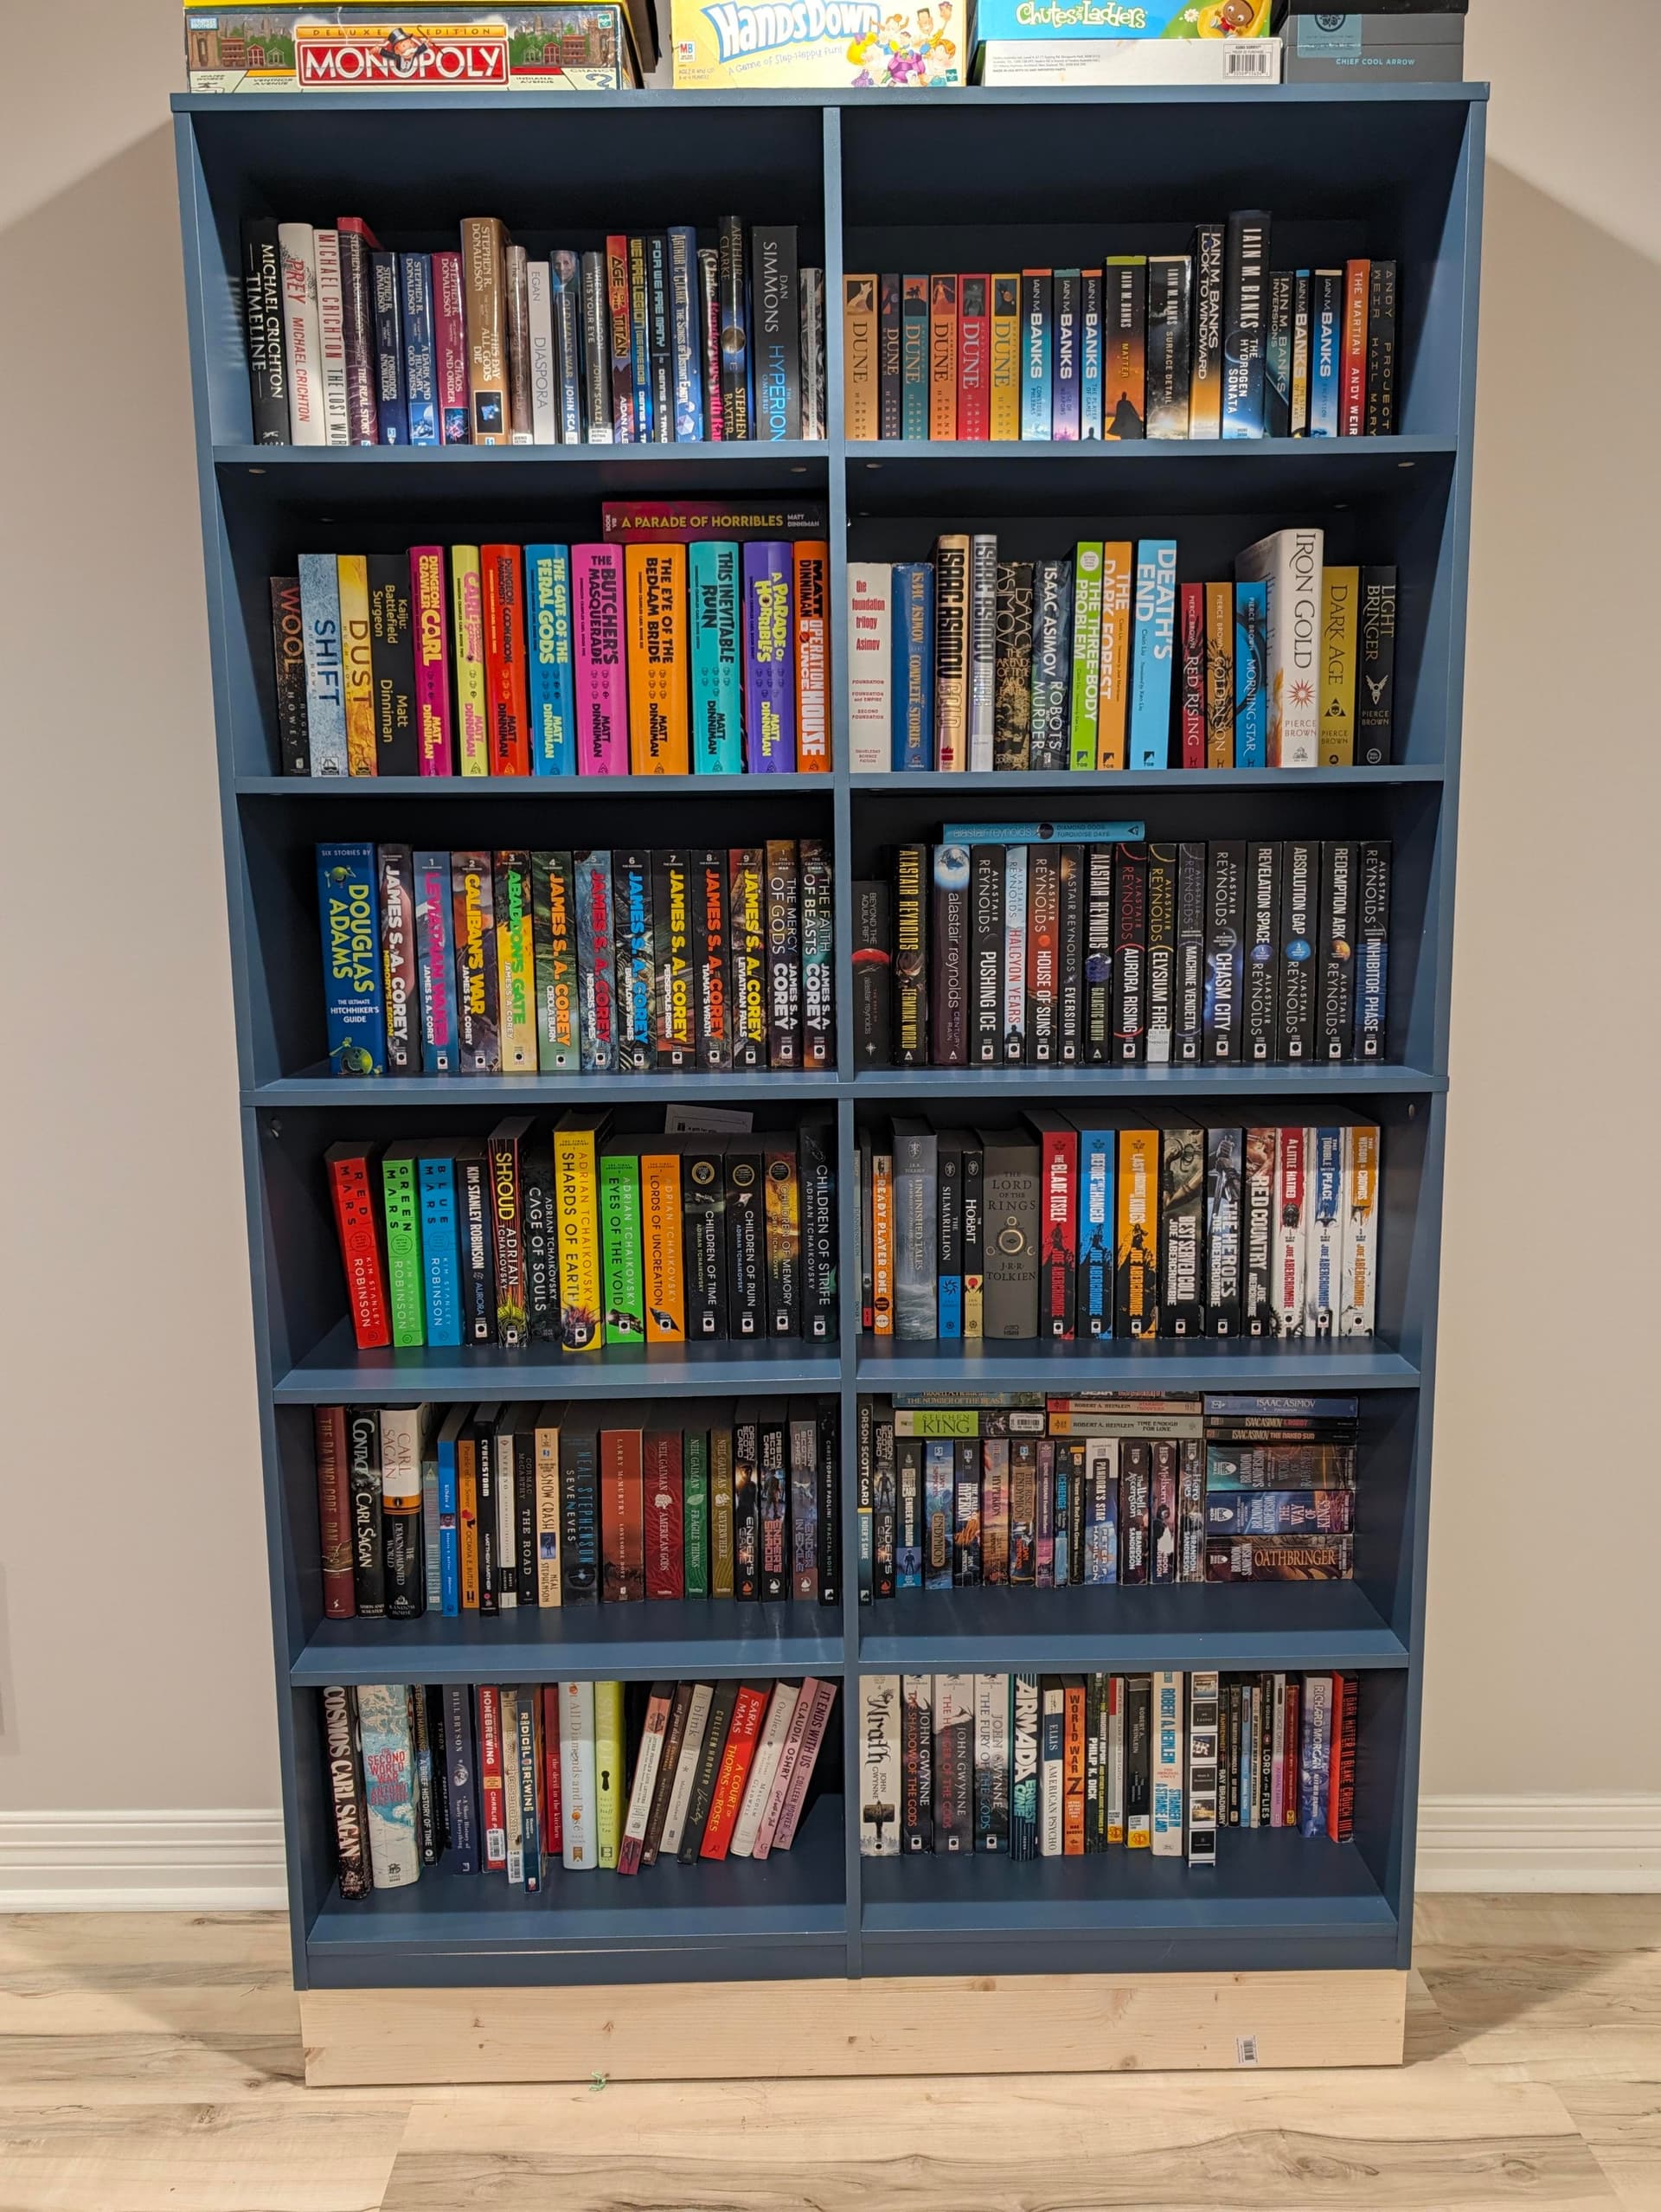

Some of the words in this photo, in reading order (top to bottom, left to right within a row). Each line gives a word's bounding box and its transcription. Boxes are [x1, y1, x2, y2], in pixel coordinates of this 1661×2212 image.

[1016, 2, 1076, 28] Chutes
[1082, 0, 1145, 28] Ladders
[680, 44, 693, 54] MB
[736, 61, 761, 73] Game
[764, 56, 773, 66] of
[318, 234, 338, 290] MICHAEL
[1242, 228, 1261, 258] IAIN
[260, 244, 273, 313] MICHAEL
[285, 257, 306, 304] PREY
[531, 272, 541, 301] EGAN
[763, 242, 779, 332] SIMMONS
[779, 276, 788, 299] DAN
[1241, 266, 1260, 282] M.
[247, 274, 266, 371] TIMELINE
[322, 297, 343, 358] CRICHTON
[1241, 285, 1260, 328] BANKS
[1352, 300, 1362, 355] MARTIAN
[266, 317, 284, 399] CRICHTON
[853, 323, 867, 383] DUNE
[963, 323, 978, 388] DUNE
[1030, 313, 1042, 378] BANKS
[327, 369, 343, 388] THE
[535, 337, 548, 408] DIASPORA
[768, 346, 786, 441] HYPERION
[1350, 368, 1359, 399] ANDY
[328, 393, 346, 417] LOST
[1349, 402, 1358, 435] WEIR
[621, 517, 631, 528] A
[635, 516, 687, 528] PARADE
[690, 516, 708, 526] OF
[712, 516, 783, 527] HORRIBLES
[1289, 533, 1316, 593] IRON
[646, 557, 659, 616] BEDLAM
[700, 585, 717, 628] RUN
[852, 599, 885, 611] foundation
[856, 580, 866, 593] the
[1044, 567, 1057, 612] ISAAC
[1102, 561, 1116, 617] DARK
[1135, 564, 1156, 622] END
[1154, 549, 1176, 659] DEATH'S
[373, 591, 383, 637] Surgeon
[385, 585, 398, 644] Battlefield
[397, 599, 407, 629] Kaiju:
[589, 568, 602, 664] MASQUERADE
[600, 568, 618, 664] BUTCHER'S
[856, 616, 877, 630] trilogy
[1074, 580, 1087, 659] PROBLEM
[1294, 600, 1315, 669] GOLD
[420, 609, 442, 667] CARL
[648, 621, 660, 664] BRIDE
[856, 638, 880, 651] Asimov
[1042, 617, 1056, 676] ASIMOV
[314, 619, 339, 706] SHIFT
[349, 620, 373, 708] DUST
[1100, 624, 1114, 699] FOREST
[802, 691, 824, 756] HOUSE
[804, 875, 815, 895] OF
[899, 850, 919, 895] ALASTAIR
[1257, 849, 1272, 905] REVELATION
[1292, 847, 1307, 909] ABSOLUTION
[465, 874, 484, 969] CALIBAN'S
[670, 869, 684, 932] JAMES
[329, 899, 353, 979] ADAMS
[348, 885, 374, 992] DOUGLAS
[805, 899, 817, 955] BEASTS
[899, 901, 919, 950] REYNOLDS
[1256, 906, 1270, 944] SPACE
[1292, 914, 1305, 934] GAP
[469, 974, 484, 1014] WAR
[980, 952, 996, 1010] PUSHING
[1215, 953, 1232, 998] CHASM
[673, 980, 686, 1042] COREY
[980, 1015, 996, 1031] ICE
[1214, 1003, 1231, 1030] CITY
[496, 1152, 515, 1220] SHROUD
[609, 1177, 621, 1209] EYES
[876, 1180, 886, 1218] READY
[993, 1181, 1031, 1189] LORD
[1051, 1164, 1067, 1196] BLADE
[611, 1216, 621, 1234] OF
[942, 1187, 951, 1260] SILMARILLION
[965, 1199, 977, 1244] HOBBIT
[988, 1201, 1036, 1210] RINGS
[1050, 1198, 1067, 1221] ITSELF
[531, 1237, 543, 1254] OF
[611, 1241, 622, 1264] THE
[706, 1211, 715, 1261] CHILDREN
[877, 1222, 886, 1266] PLAYER
[354, 1259, 371, 1327] ROBINSON
[533, 1263, 546, 1311] SOULS
[612, 1272, 624, 1305] VOID
[707, 1265, 716, 1279] OF
[708, 1282, 716, 1305] TIME
[877, 1271, 886, 1294] ONE
[986, 1272, 1036, 1280] TOLKIEN
[923, 1420, 969, 1433] KING
[541, 1474, 554, 1498] SNOW
[356, 1493, 372, 1524] CARL
[542, 1502, 555, 1529] CRASH
[358, 1528, 375, 1568] SAGAN
[718, 1510, 727, 1559] NEVERWHERE
[934, 1516, 943, 1565] ENDYMION
[523, 1541, 531, 1575] ROAD
[1254, 1550, 1336, 1566] OATHBRINGER
[542, 1562, 550, 1601] STEPHENSON
[324, 1687, 352, 1757] COSMOS
[484, 1691, 494, 1765] HOMEBREWING
[744, 1701, 760, 1735] SARAH
[791, 1701, 808, 1746] CLAUDIA
[920, 1711, 929, 1745] JOHN
[1070, 1696, 1080, 1741] WORLD
[1314, 1686, 1324, 1727] RICHARD
[1016, 1682, 1037, 1784] ARMADA
[1049, 1725, 1058, 1751] ELLIS
[1313, 1730, 1323, 1770] MORGAN
[331, 1761, 354, 1802] CARL
[782, 1747, 794, 1780] OSHRY
[920, 1750, 929, 1806] GWYNNE
[1070, 1747, 1080, 1773] WAR
[1049, 1766, 1057, 1812] AMERICAN
[1066, 1778, 1082, 1795] Z
[1088, 1780, 1097, 1799] DICK
[336, 1805, 360, 1858] SAGAN
[709, 1799, 723, 1832] ROSES
